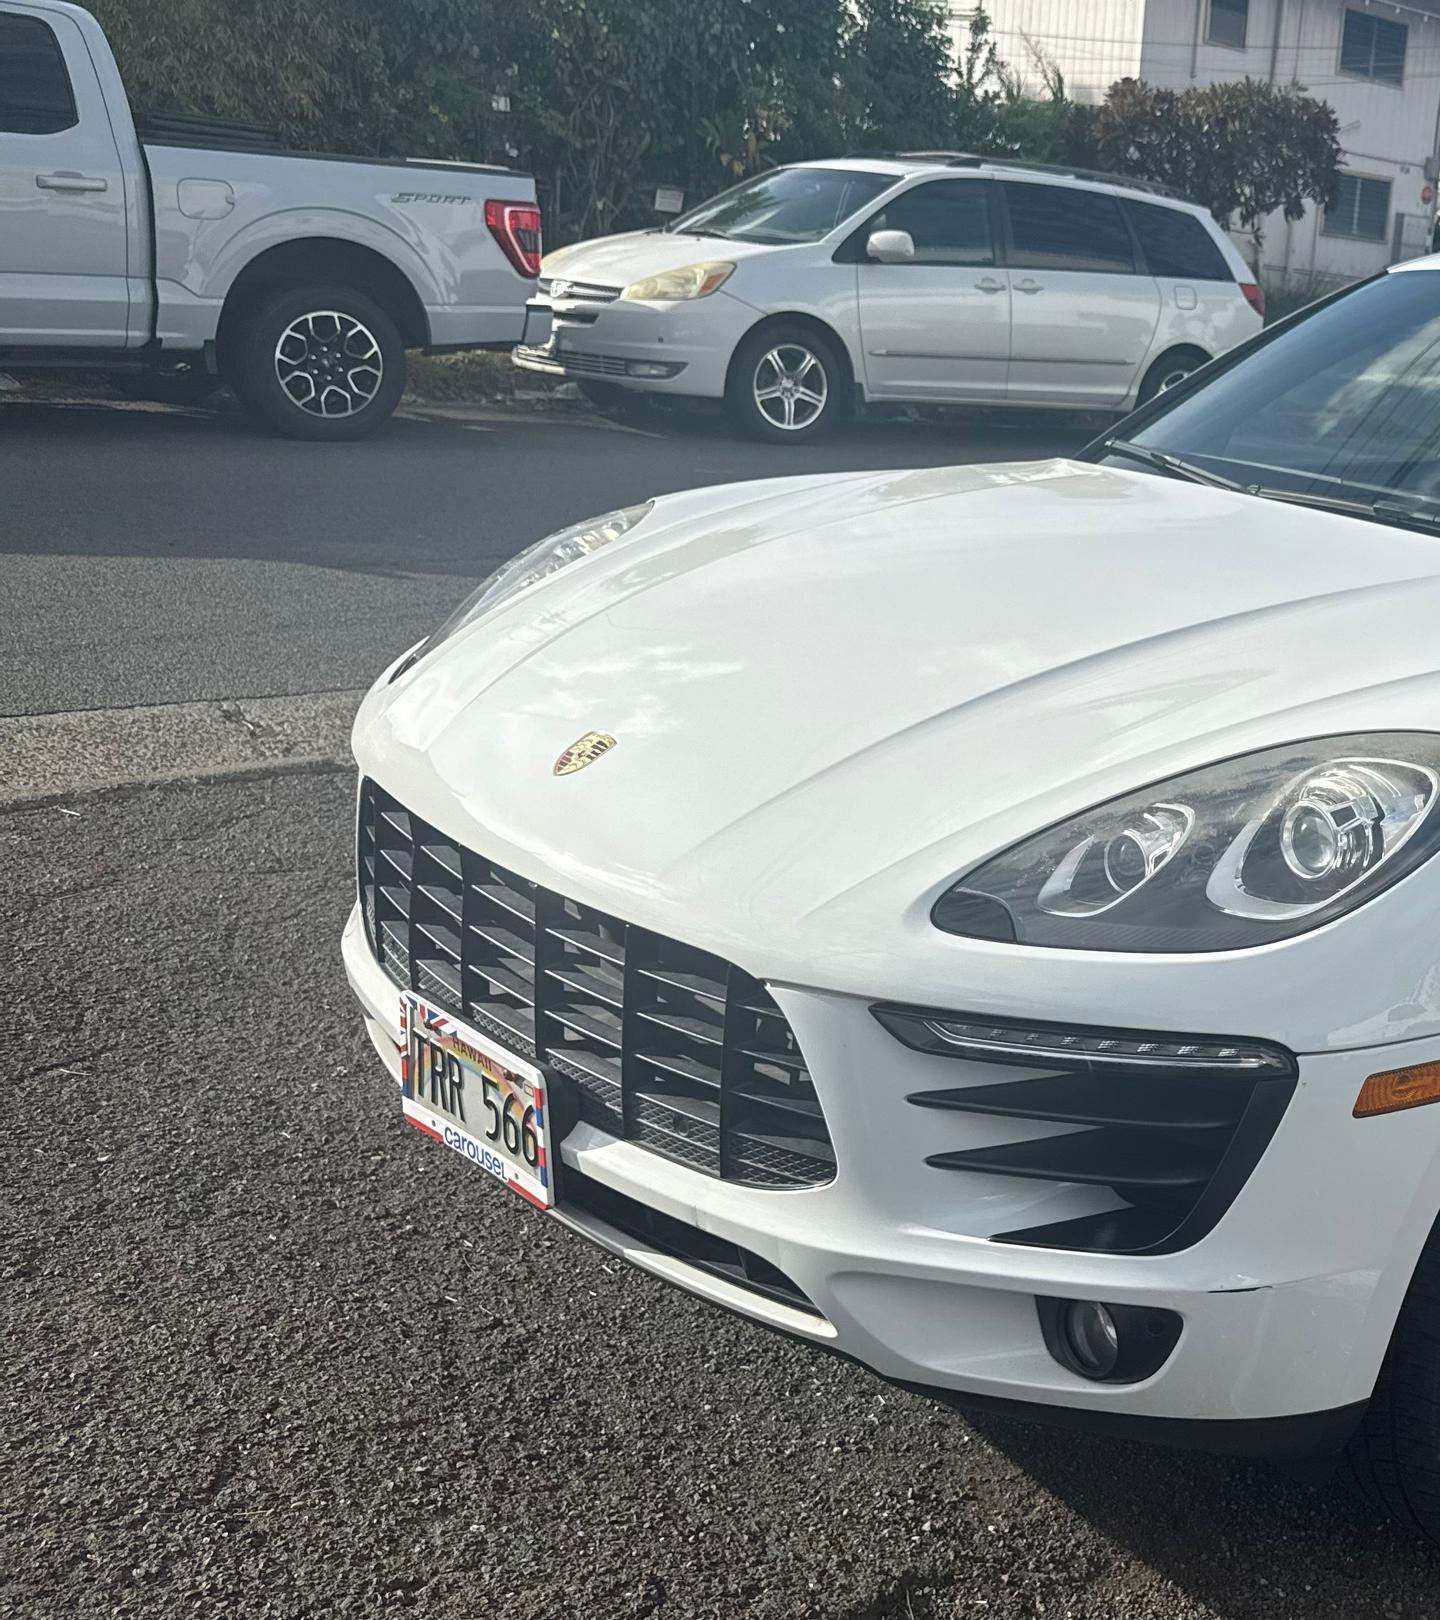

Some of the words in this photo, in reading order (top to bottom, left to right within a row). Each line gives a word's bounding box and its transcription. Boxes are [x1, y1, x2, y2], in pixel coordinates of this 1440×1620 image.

[391, 192, 472, 205] SPORT
[452, 1036, 492, 1072] HAWAII
[413, 1030, 467, 1124] TRR
[481, 1072, 538, 1168] 566
